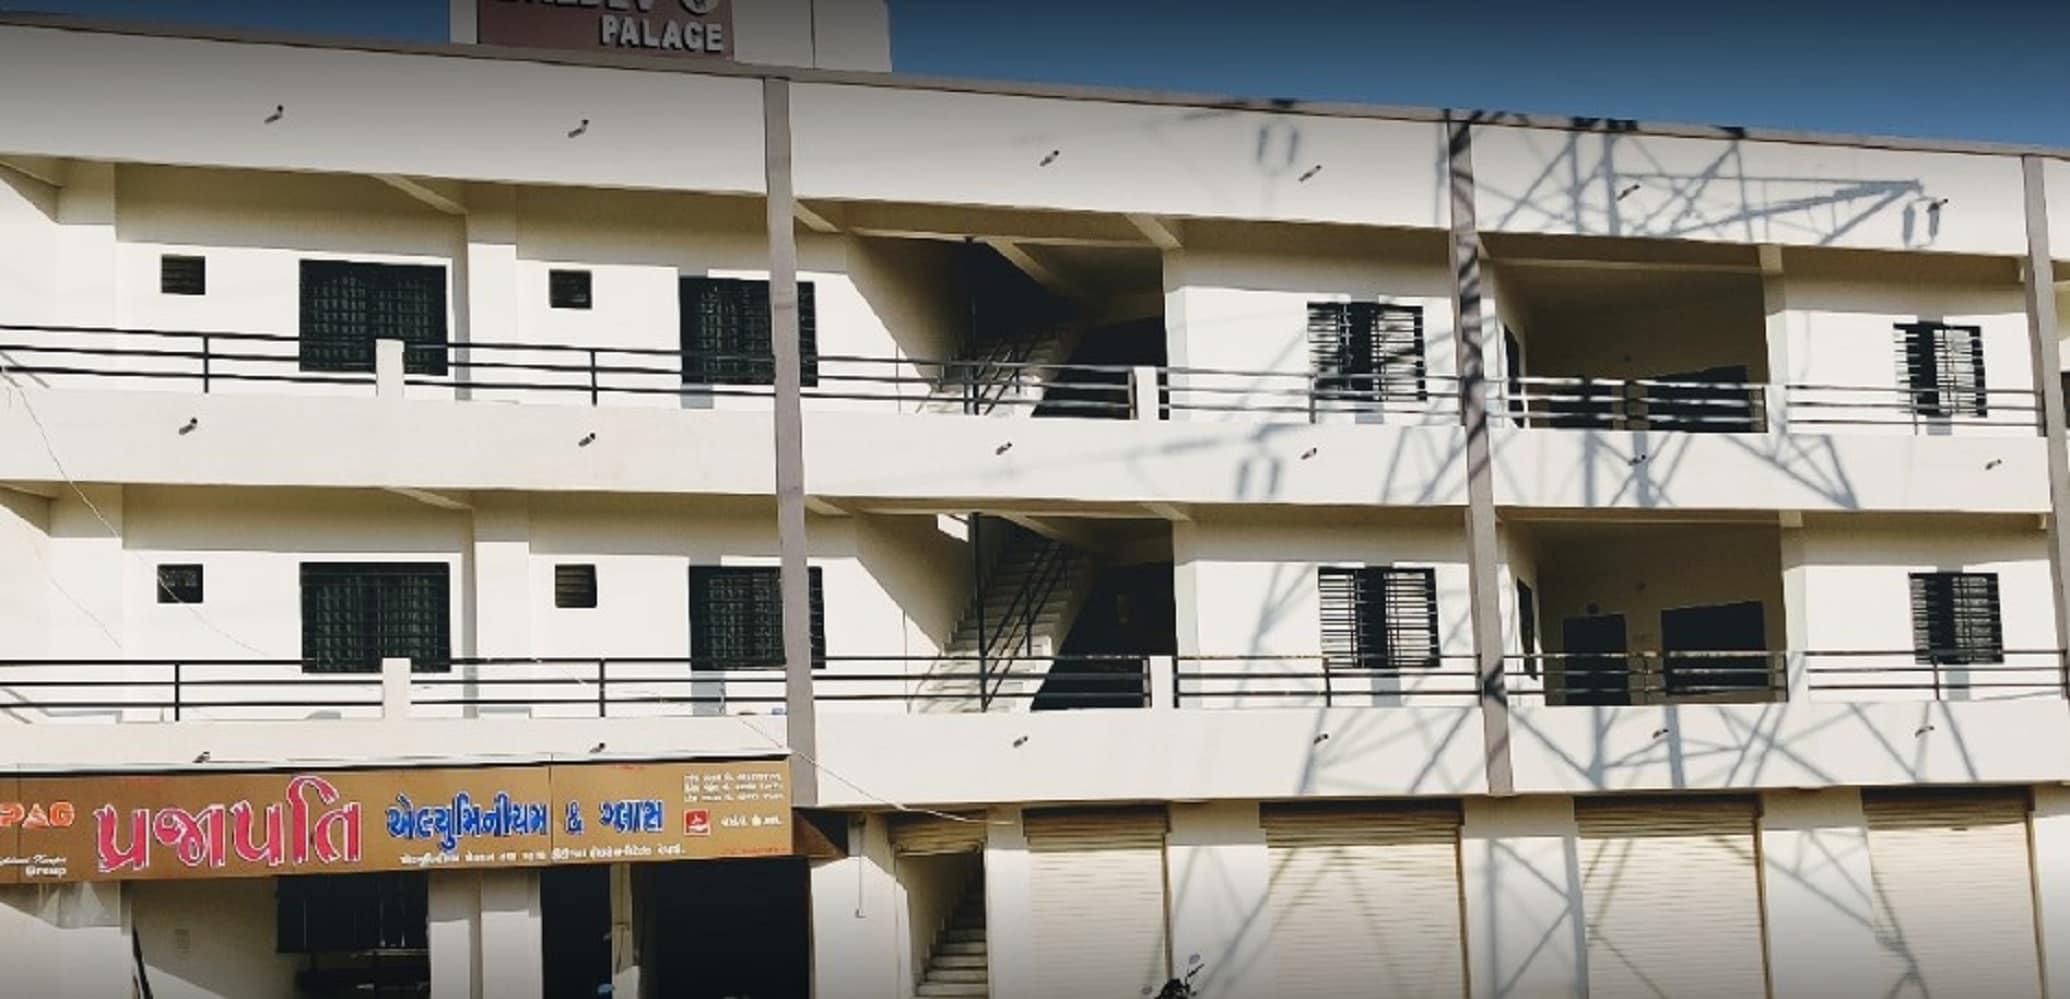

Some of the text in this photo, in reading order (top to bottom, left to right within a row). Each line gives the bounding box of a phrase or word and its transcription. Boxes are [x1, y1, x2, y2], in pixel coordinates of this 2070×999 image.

[600, 14, 723, 51] PALACE
[93, 775, 362, 872] પ્રજાપતિ
[564, 800, 583, 835] &
[599, 799, 665, 833] ગ્લાસ
